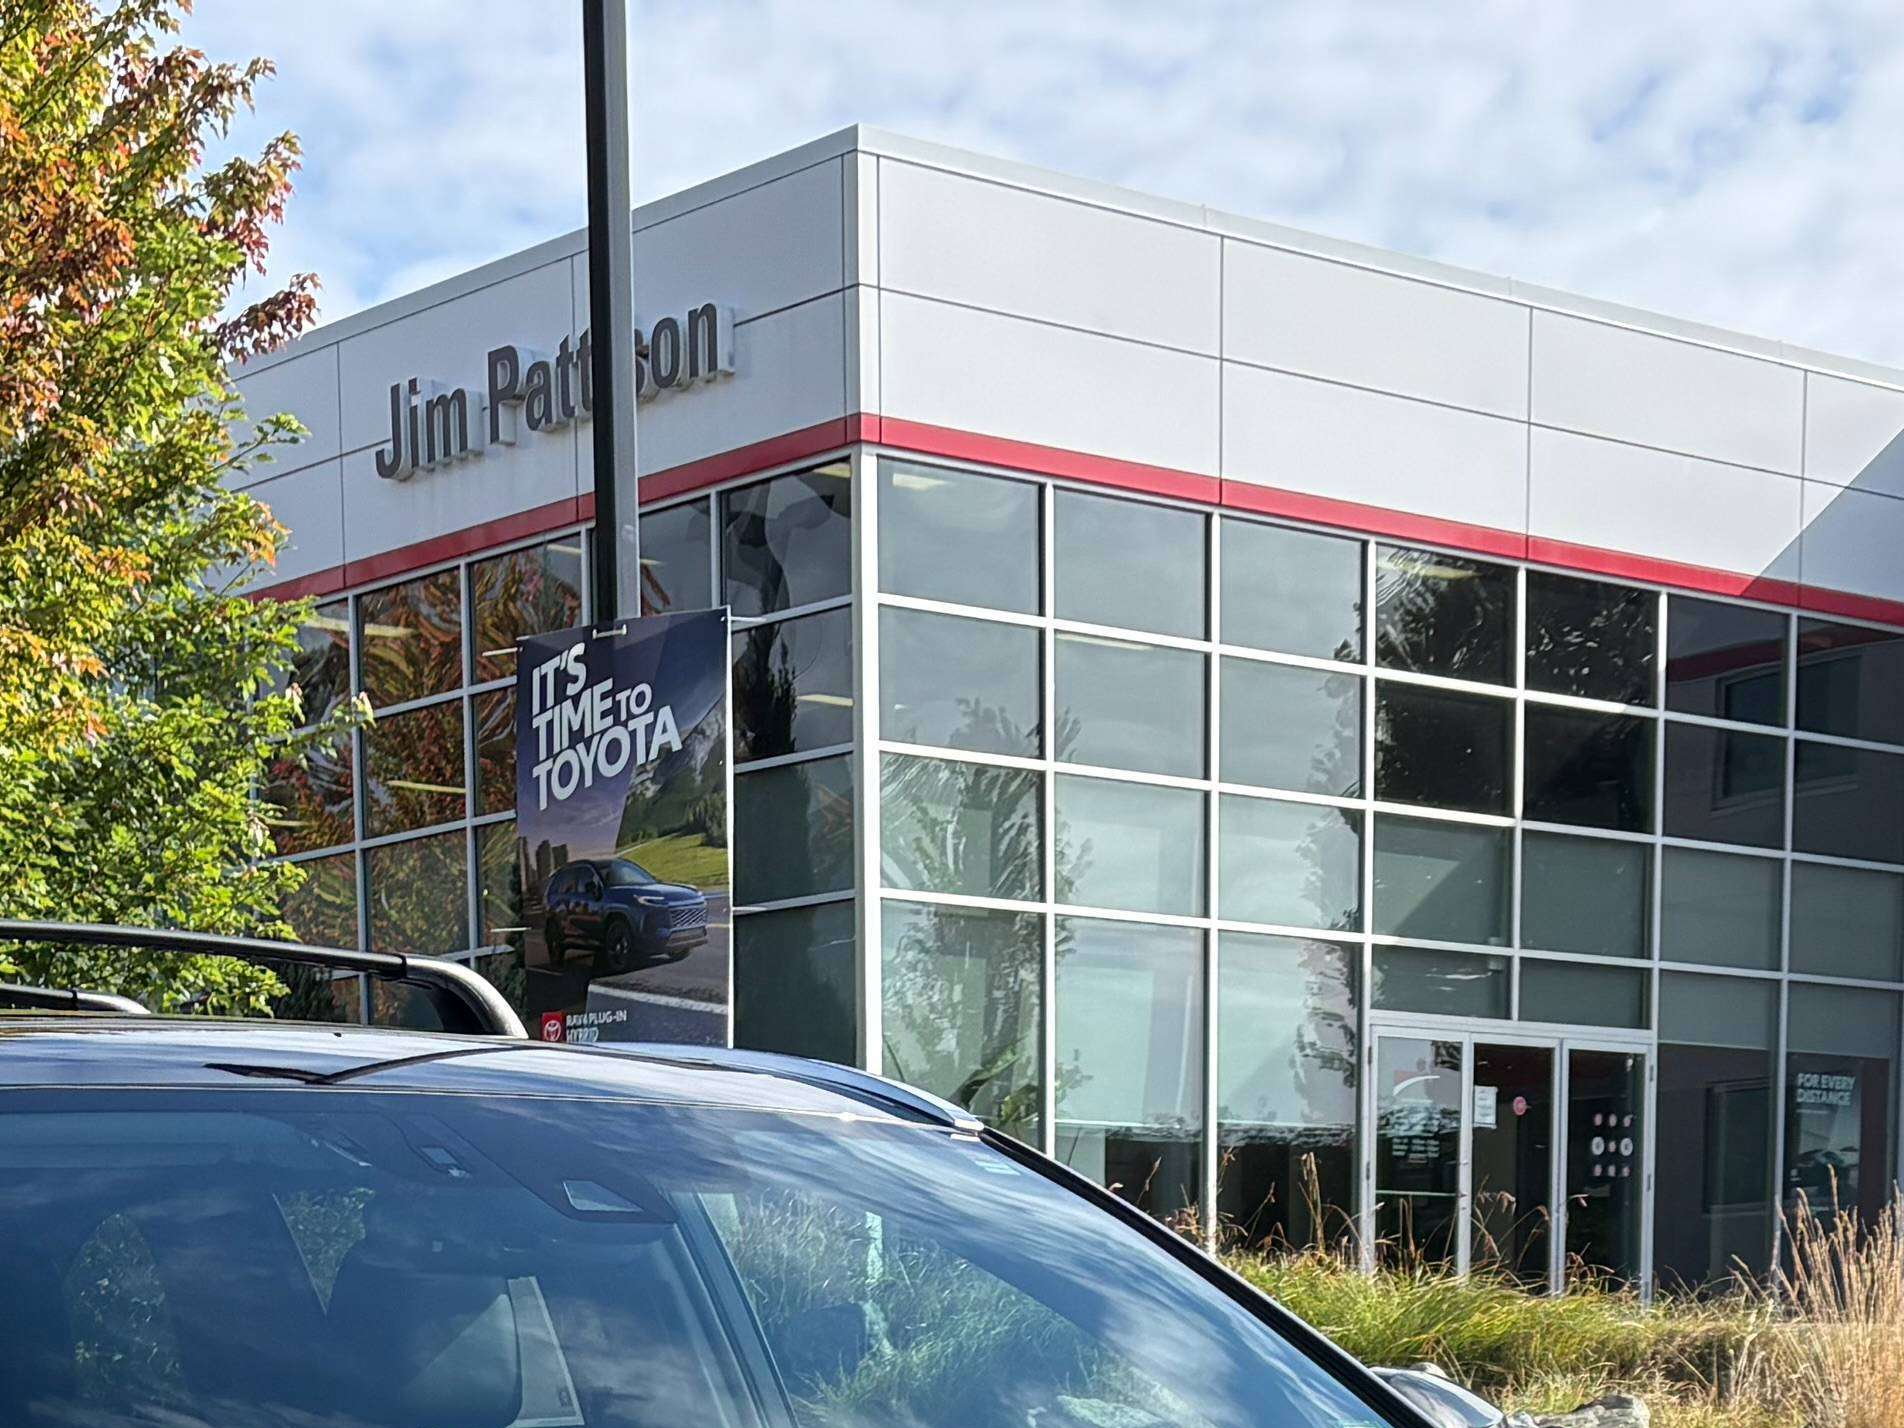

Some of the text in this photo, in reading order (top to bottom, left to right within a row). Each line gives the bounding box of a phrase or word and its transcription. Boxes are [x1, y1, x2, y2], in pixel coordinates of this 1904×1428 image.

[375, 302, 719, 480] Jim Patton
[532, 642, 586, 717] IT'S
[532, 678, 652, 762] TIME TO
[532, 705, 683, 811] TOYOTA
[589, 1009, 628, 1025] PLUG-IN
[1797, 1088, 1851, 1105] DISTANCE
[1798, 1073, 1855, 1090] FOR EVERY
